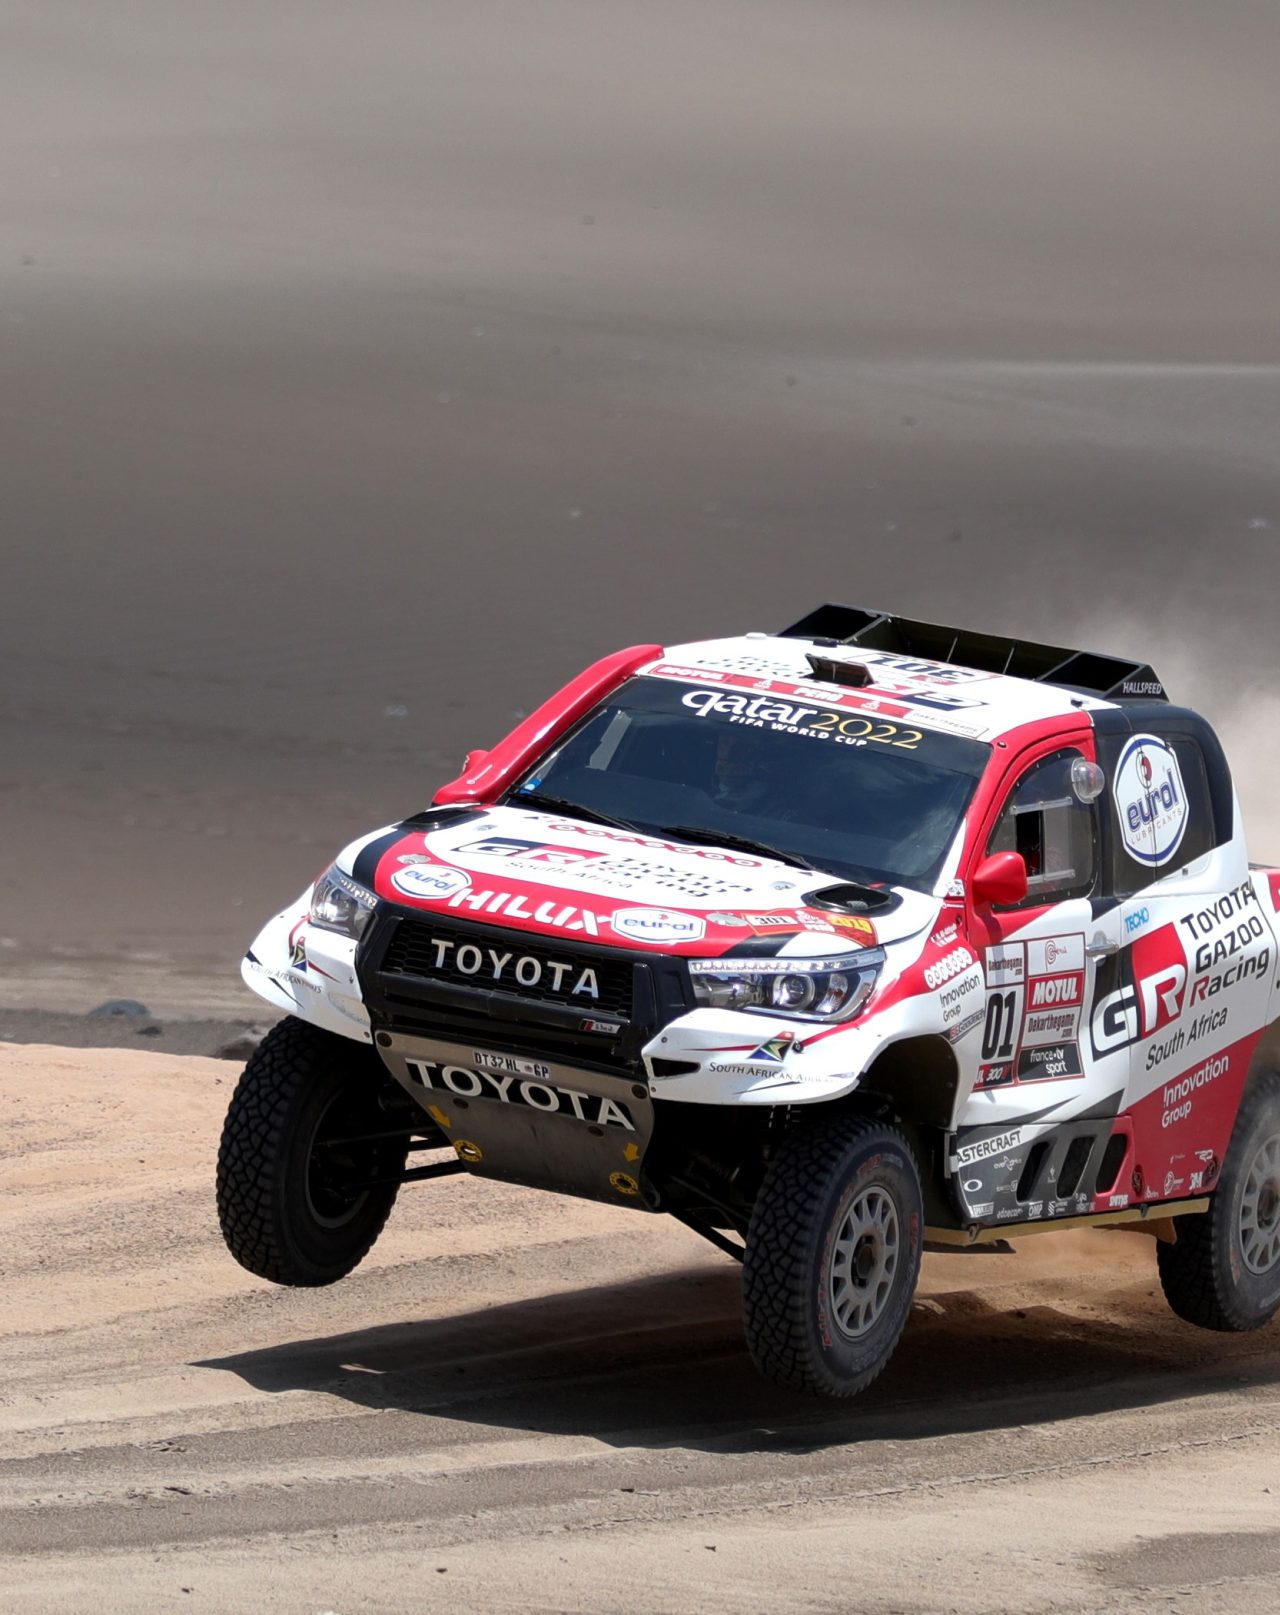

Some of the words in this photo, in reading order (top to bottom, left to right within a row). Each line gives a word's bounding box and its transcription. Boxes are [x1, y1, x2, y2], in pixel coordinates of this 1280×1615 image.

[1123, 682, 1161, 694] HALLSPEED
[682, 690, 817, 725] qatar
[809, 713, 923, 749] 2022
[729, 715, 763, 727] FIFA
[771, 722, 829, 740] WORLD
[834, 734, 868, 747] CUP
[1127, 768, 1180, 832] eurol
[1131, 808, 1182, 845] LUBRICANTS
[404, 869, 457, 891] eurol
[623, 918, 694, 931] eurol
[1180, 881, 1256, 940] TOYOTA
[755, 916, 790, 925] 301
[1196, 916, 1263, 974] GAZOO
[431, 938, 600, 999] TOYOTA
[1190, 948, 1269, 1007] Racing
[1032, 978, 1078, 1005] MOTUL
[1093, 964, 1187, 1052] GR
[943, 1005, 961, 1022] Group
[1028, 1014, 1074, 1033] Dakarthegame
[1146, 1028, 1185, 1071] South
[1186, 1007, 1229, 1046] Africa
[533, 1066, 549, 1078] GP
[709, 1061, 745, 1074] SOUTH
[747, 1066, 793, 1080] AFRICAN
[1046, 1061, 1067, 1078] sport
[405, 1058, 635, 1131] TOYOTA
[1162, 1100, 1192, 1128] Group
